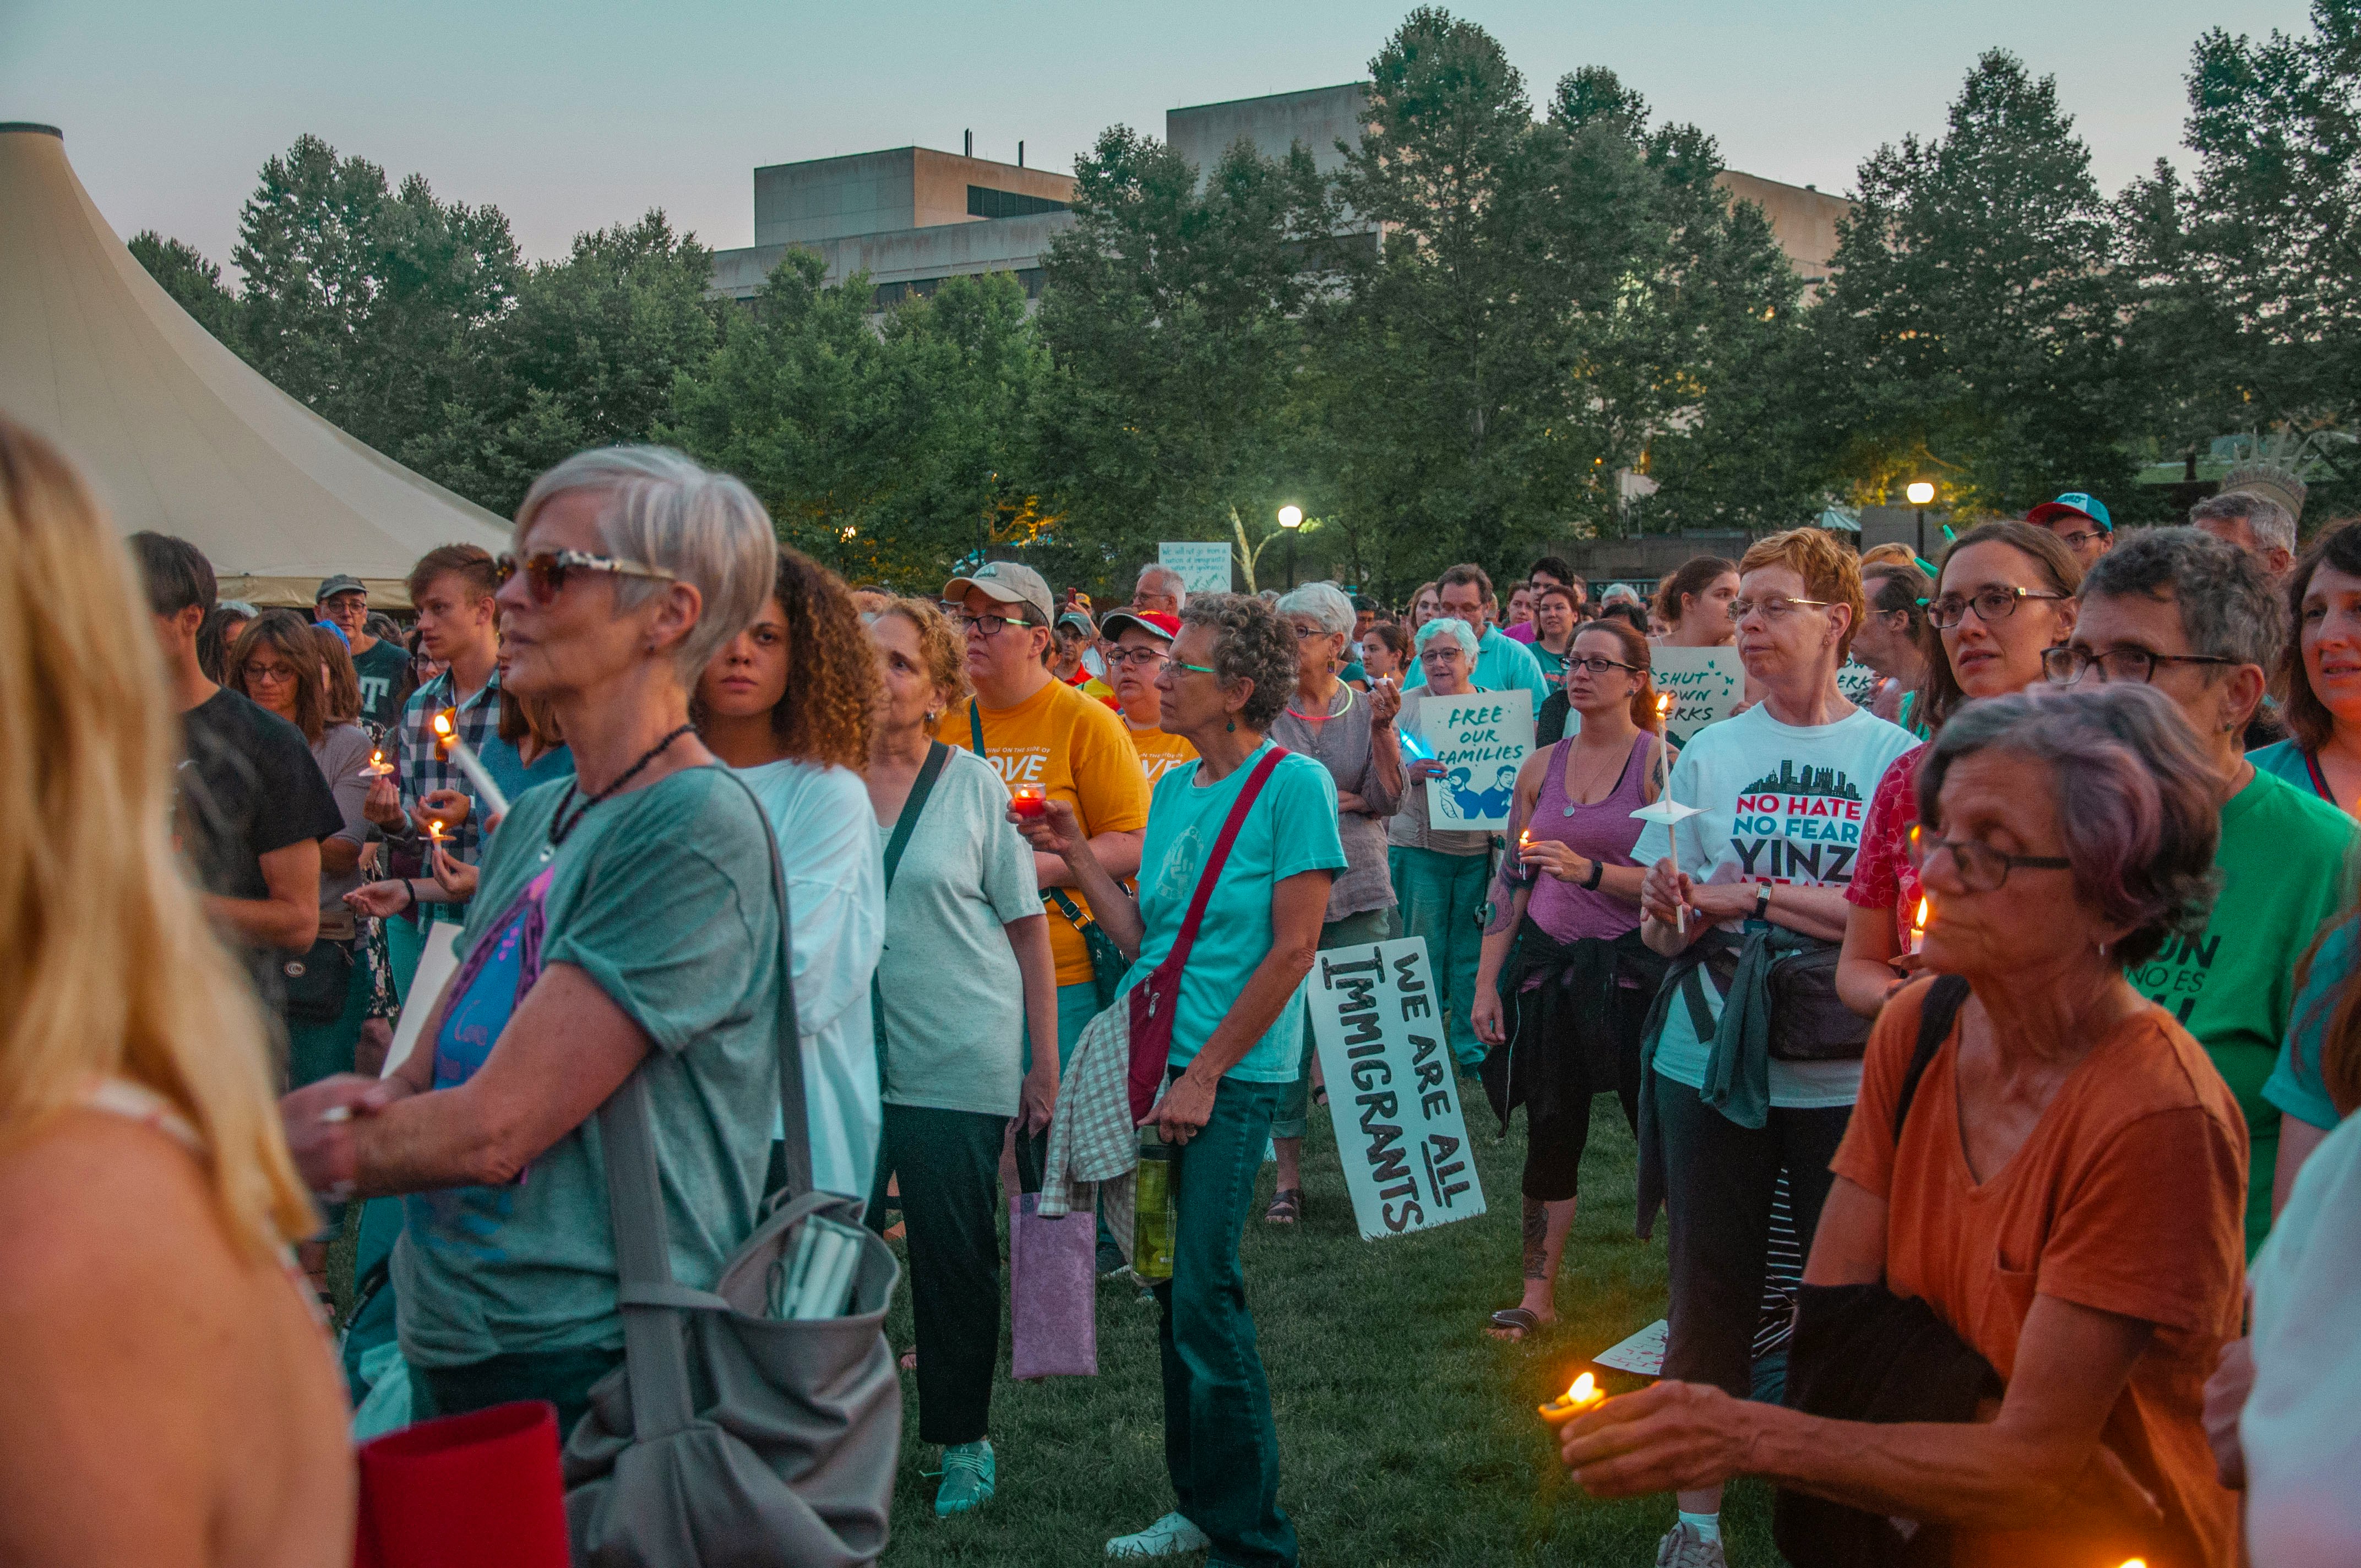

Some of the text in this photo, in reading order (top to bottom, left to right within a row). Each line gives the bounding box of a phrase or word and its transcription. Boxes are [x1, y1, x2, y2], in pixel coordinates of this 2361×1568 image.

[1658, 672, 1709, 685] SHUT
[1448, 706, 1503, 729] FREE
[1460, 728, 1499, 743] OUR
[1437, 745, 1524, 765] FAMILIES
[1736, 794, 1862, 820] NO HATE
[1732, 816, 1859, 843] NO FEAR
[1730, 839, 1858, 884] YINZ
[2173, 970, 2205, 993] ES
[1321, 946, 1424, 1233] IMMIGRANTS
[1393, 952, 1471, 1208] WE ARE ALL
